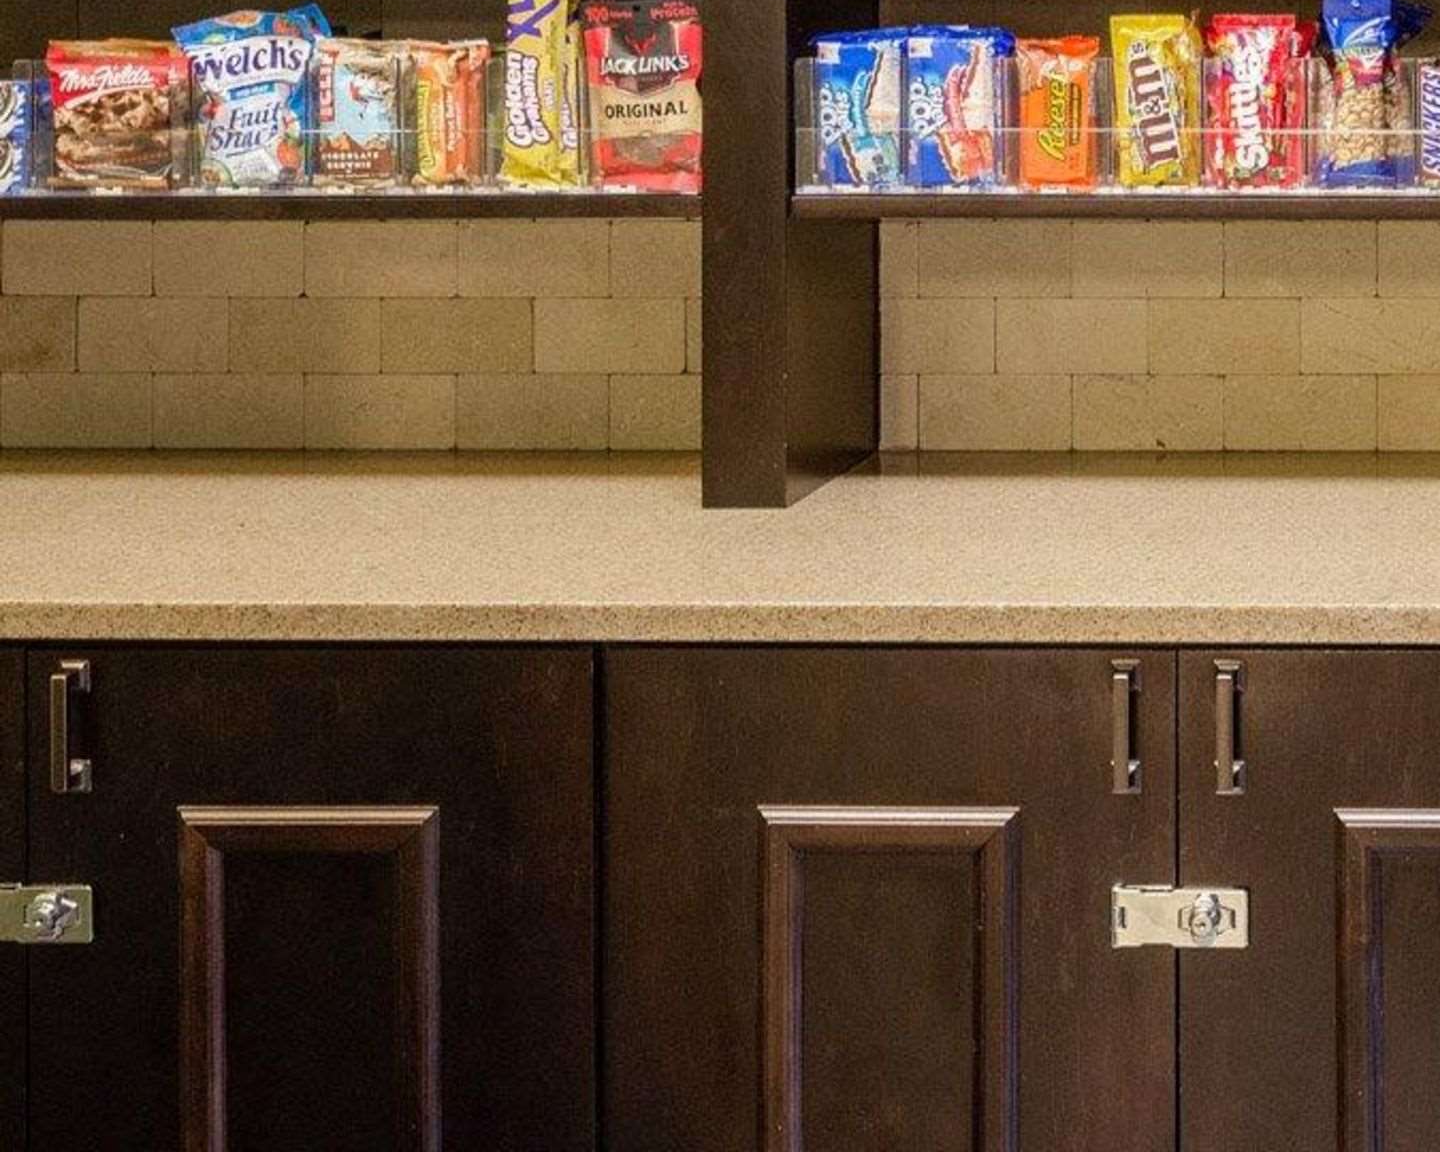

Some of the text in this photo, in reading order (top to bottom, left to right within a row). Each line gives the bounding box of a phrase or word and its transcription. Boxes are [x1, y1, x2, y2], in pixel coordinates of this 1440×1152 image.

[194, 39, 304, 82] Welch's
[600, 56, 637, 75] JACK
[229, 101, 283, 130] Fruit
[506, 51, 533, 146] Golden
[521, 56, 550, 144] Grahams
[604, 100, 689, 119] ORIGINAL
